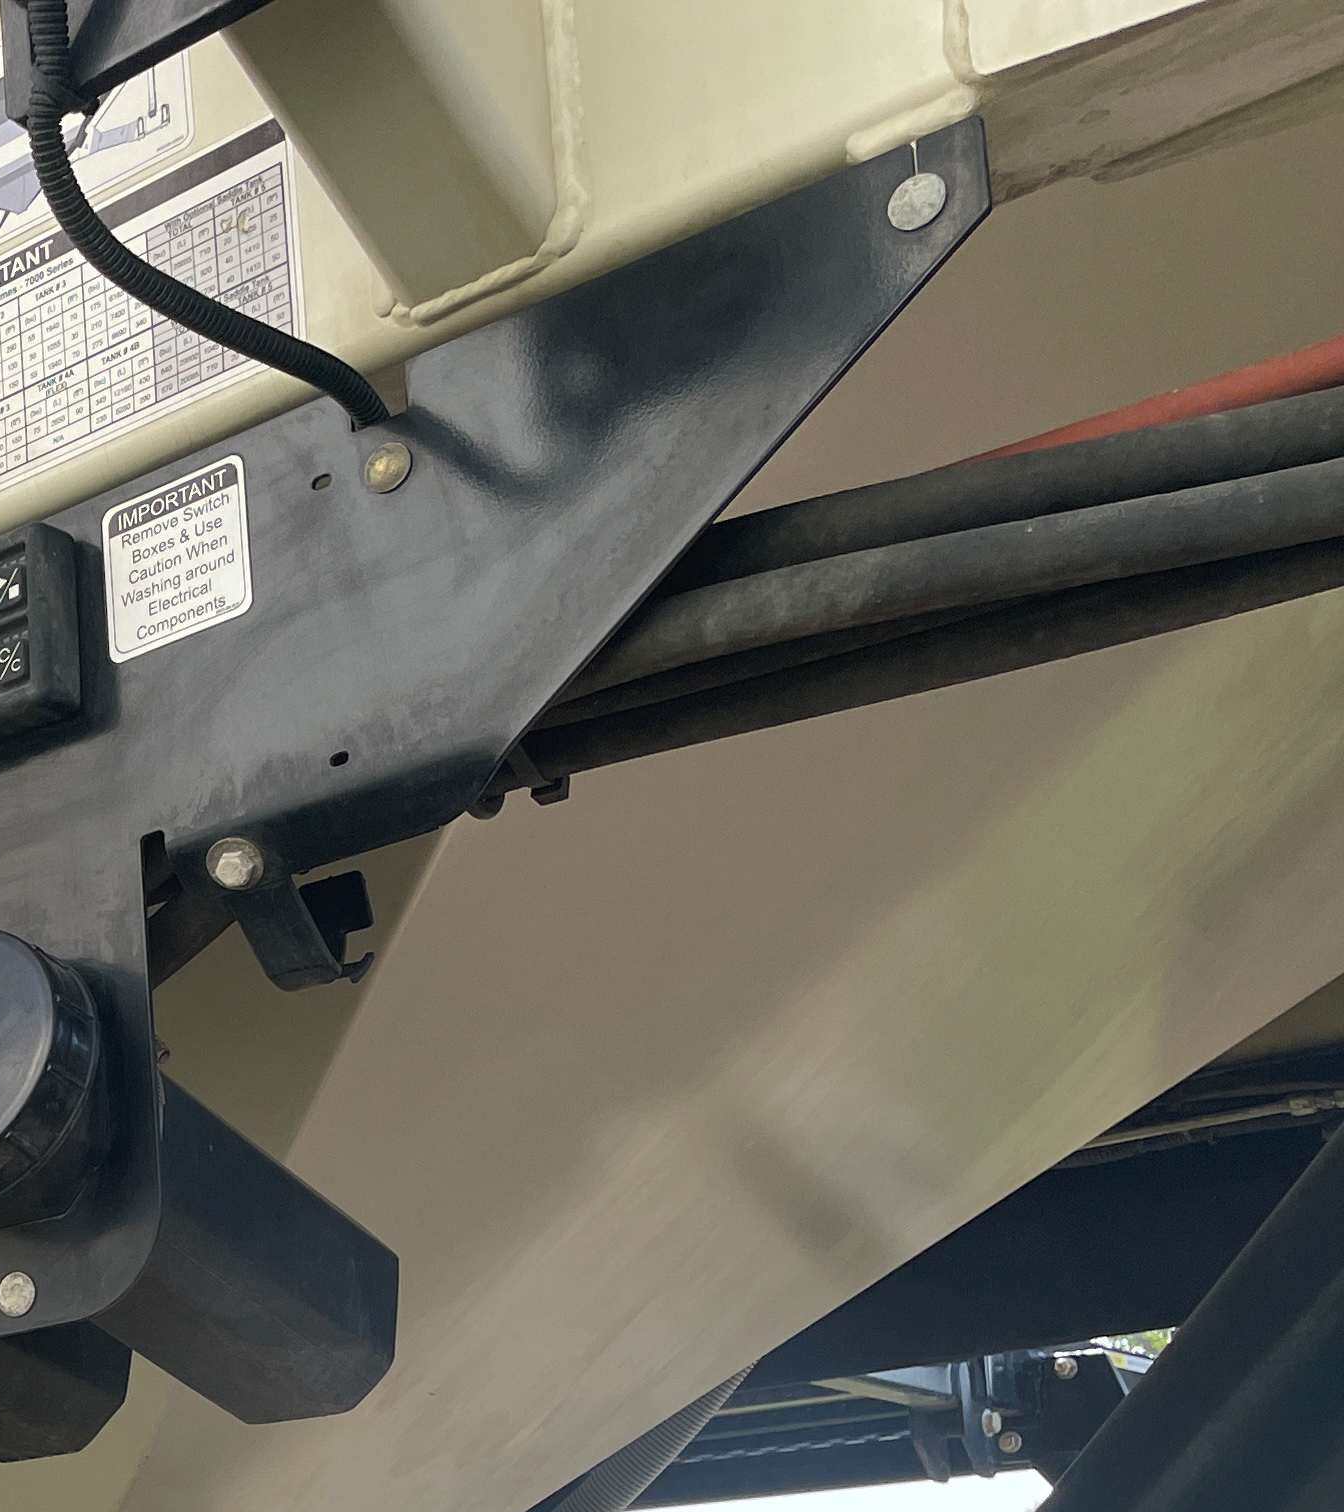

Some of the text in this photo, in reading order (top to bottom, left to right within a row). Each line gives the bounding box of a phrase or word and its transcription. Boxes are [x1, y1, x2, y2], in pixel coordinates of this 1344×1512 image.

[25, 272, 44, 287] 7000
[47, 257, 74, 275] Series
[35, 286, 54, 301] TANK
[101, 351, 119, 366] TANK
[129, 340, 139, 352] 4B
[37, 377, 56, 392] TANK
[64, 368, 74, 379] 4A
[118, 469, 227, 531] IMPORTANT
[121, 492, 229, 548] Remove Switch
[129, 535, 228, 584] Caution When
[132, 516, 223, 564] Boxes & Use
[121, 551, 235, 607] Washing around
[149, 579, 212, 616] Electrical
[137, 595, 226, 640] Components
